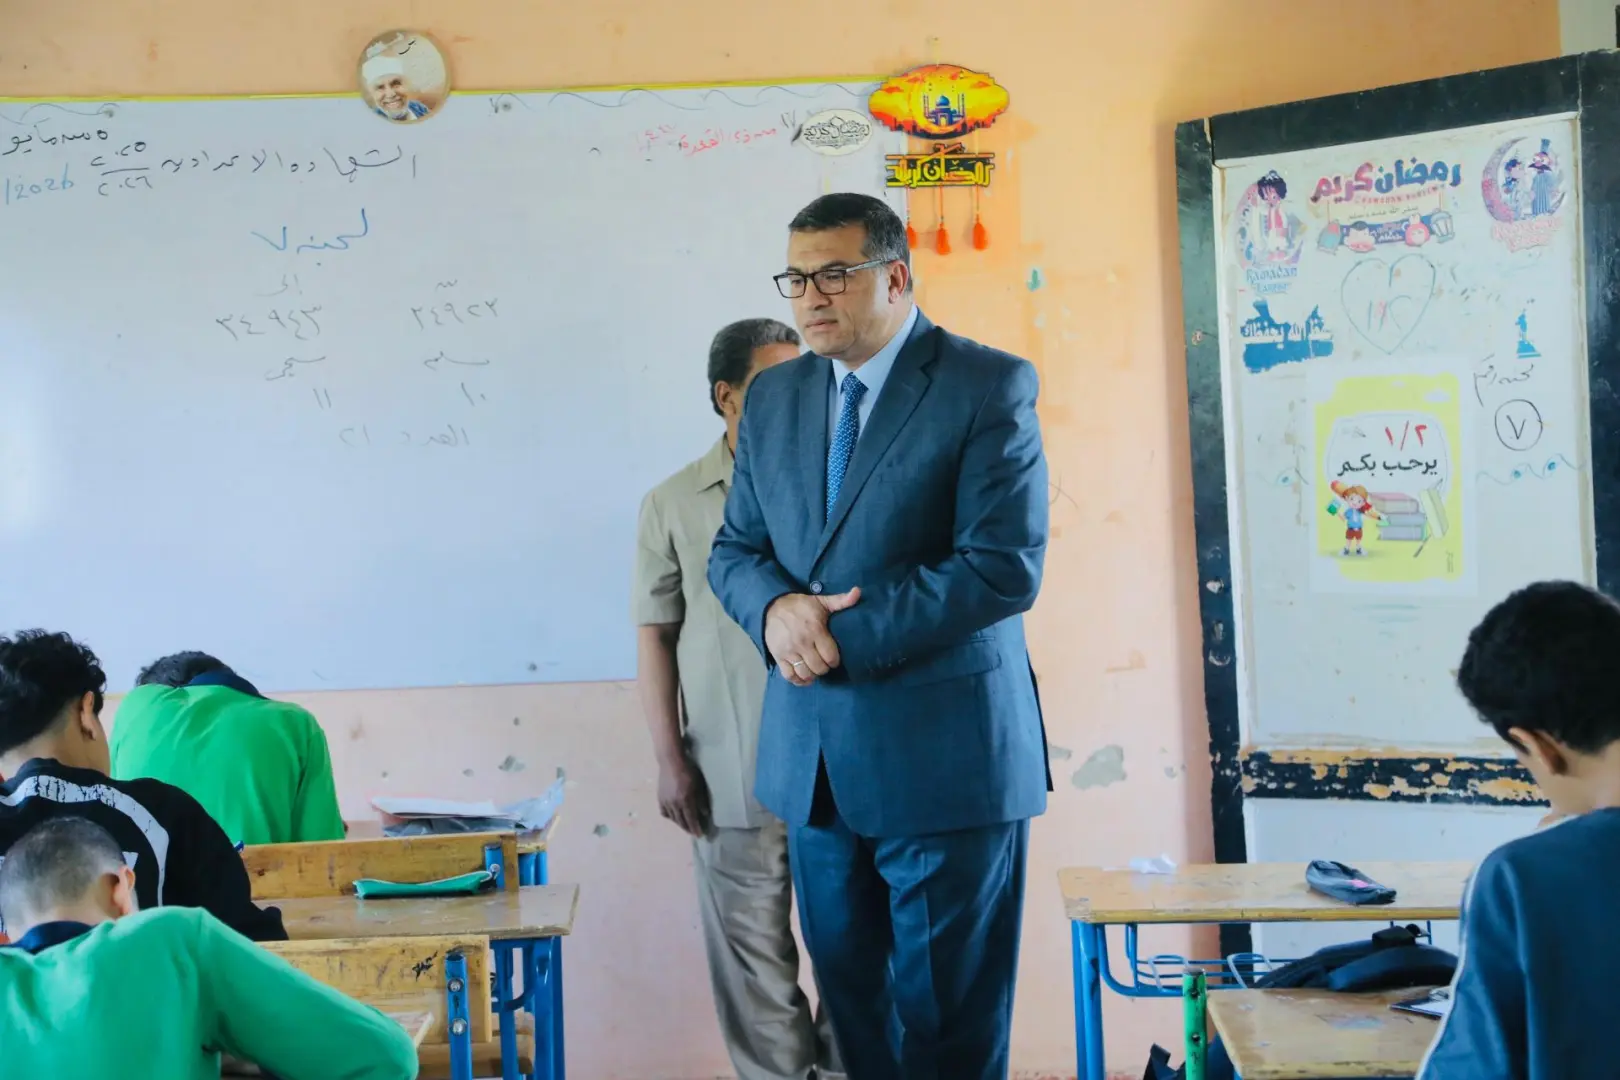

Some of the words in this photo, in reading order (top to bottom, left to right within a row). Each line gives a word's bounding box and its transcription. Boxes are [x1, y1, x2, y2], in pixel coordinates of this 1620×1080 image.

[2, 125, 58, 156] مايو
[1310, 161, 1374, 204] كريم
[1375, 156, 1462, 194] رمضان
[1336, 452, 1377, 478] بكم
[1382, 458, 1438, 477] يرحب
